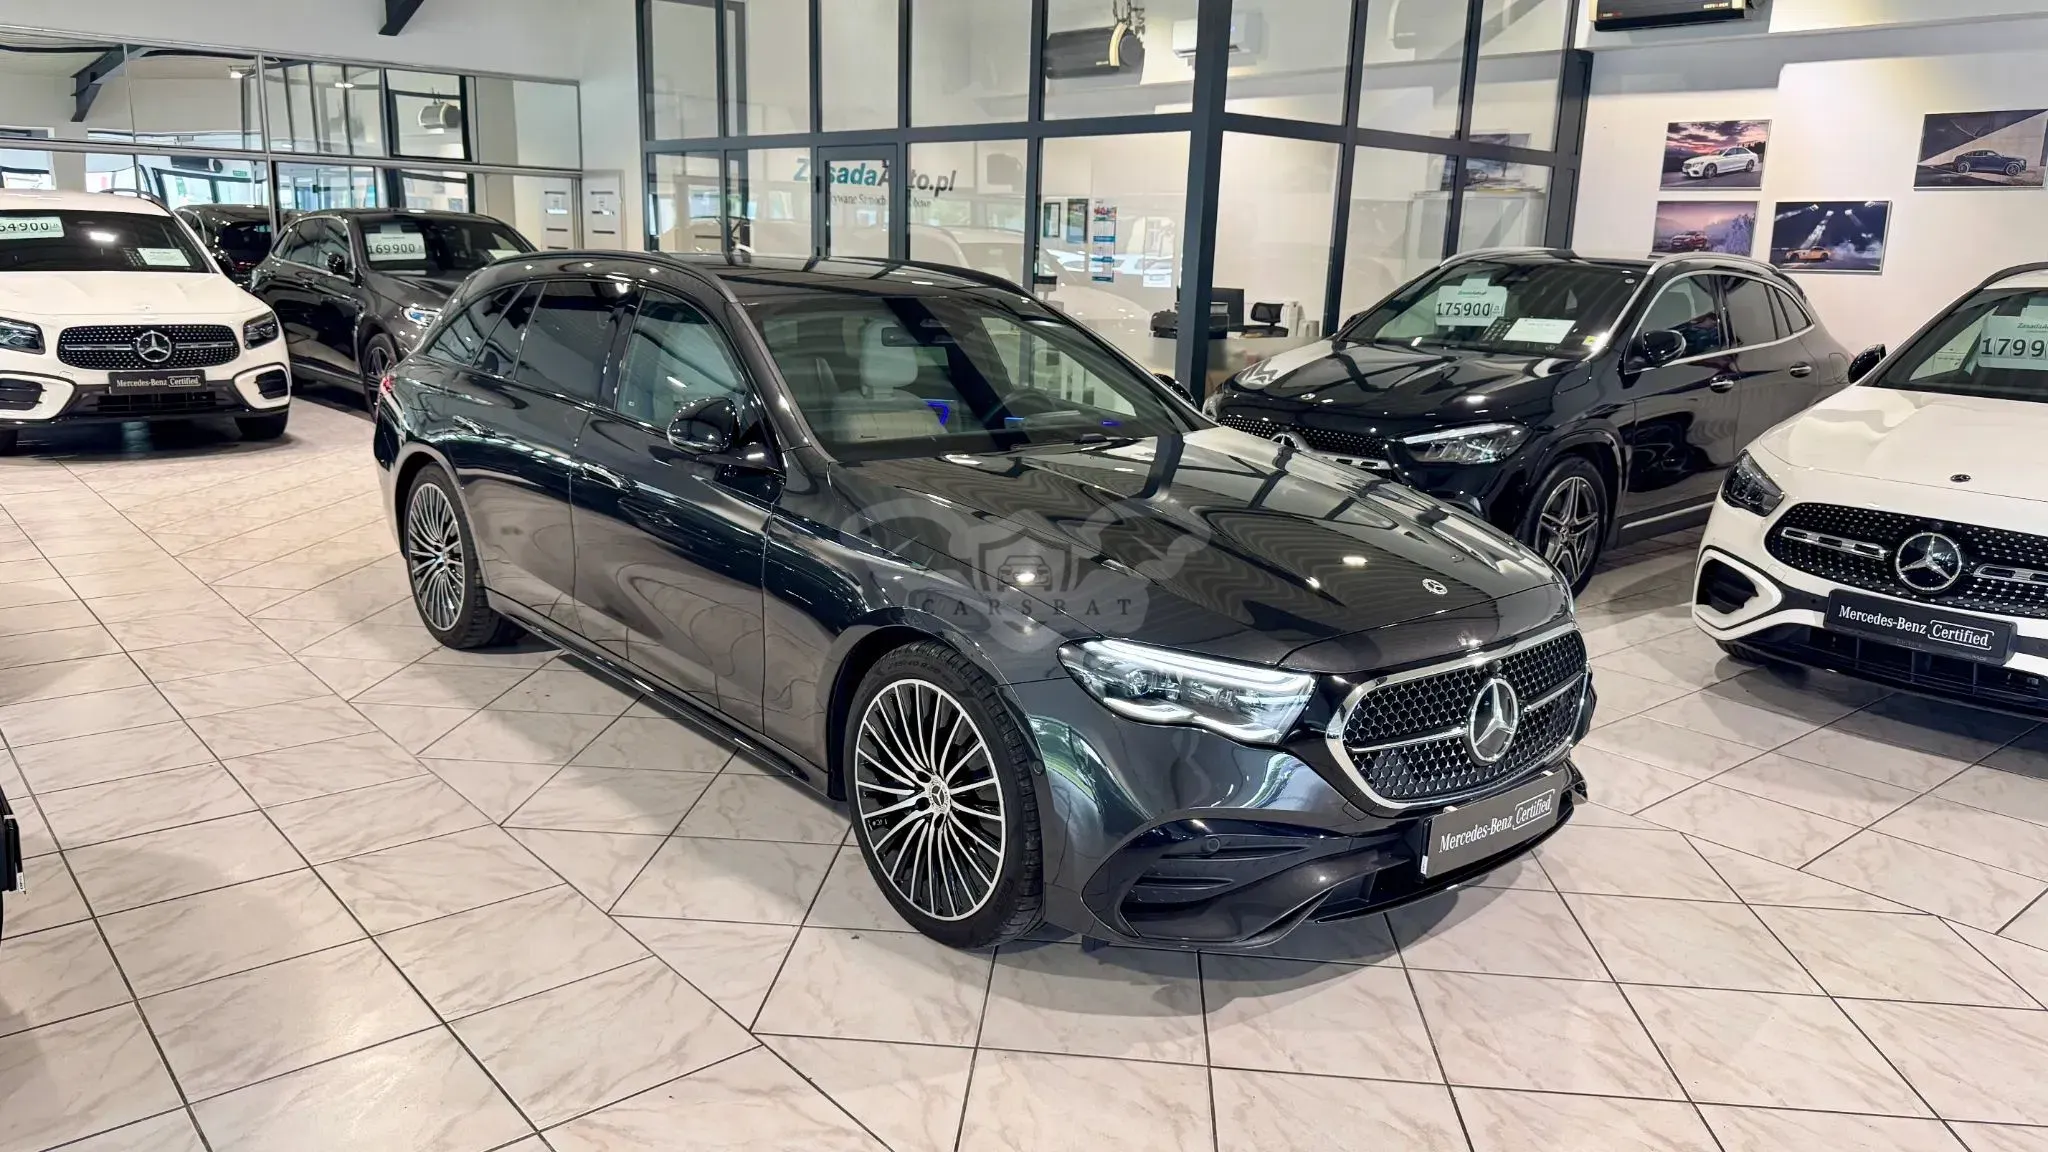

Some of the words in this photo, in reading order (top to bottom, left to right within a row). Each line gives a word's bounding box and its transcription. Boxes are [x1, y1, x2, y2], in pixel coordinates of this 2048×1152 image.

[793, 158, 957, 197] ZsadaAto.pl
[368, 243, 415, 255] 169900
[1436, 302, 1491, 316] 175900
[1981, 337, 2045, 357] 1799
[116, 378, 167, 388] Mercedes-Benz
[169, 377, 199, 386] Certified
[1838, 604, 1927, 635] Mercedes-Benz
[1932, 623, 1989, 647] Certified
[1438, 815, 1513, 854] Mercedes-Benz
[1515, 794, 1553, 825] Certified
